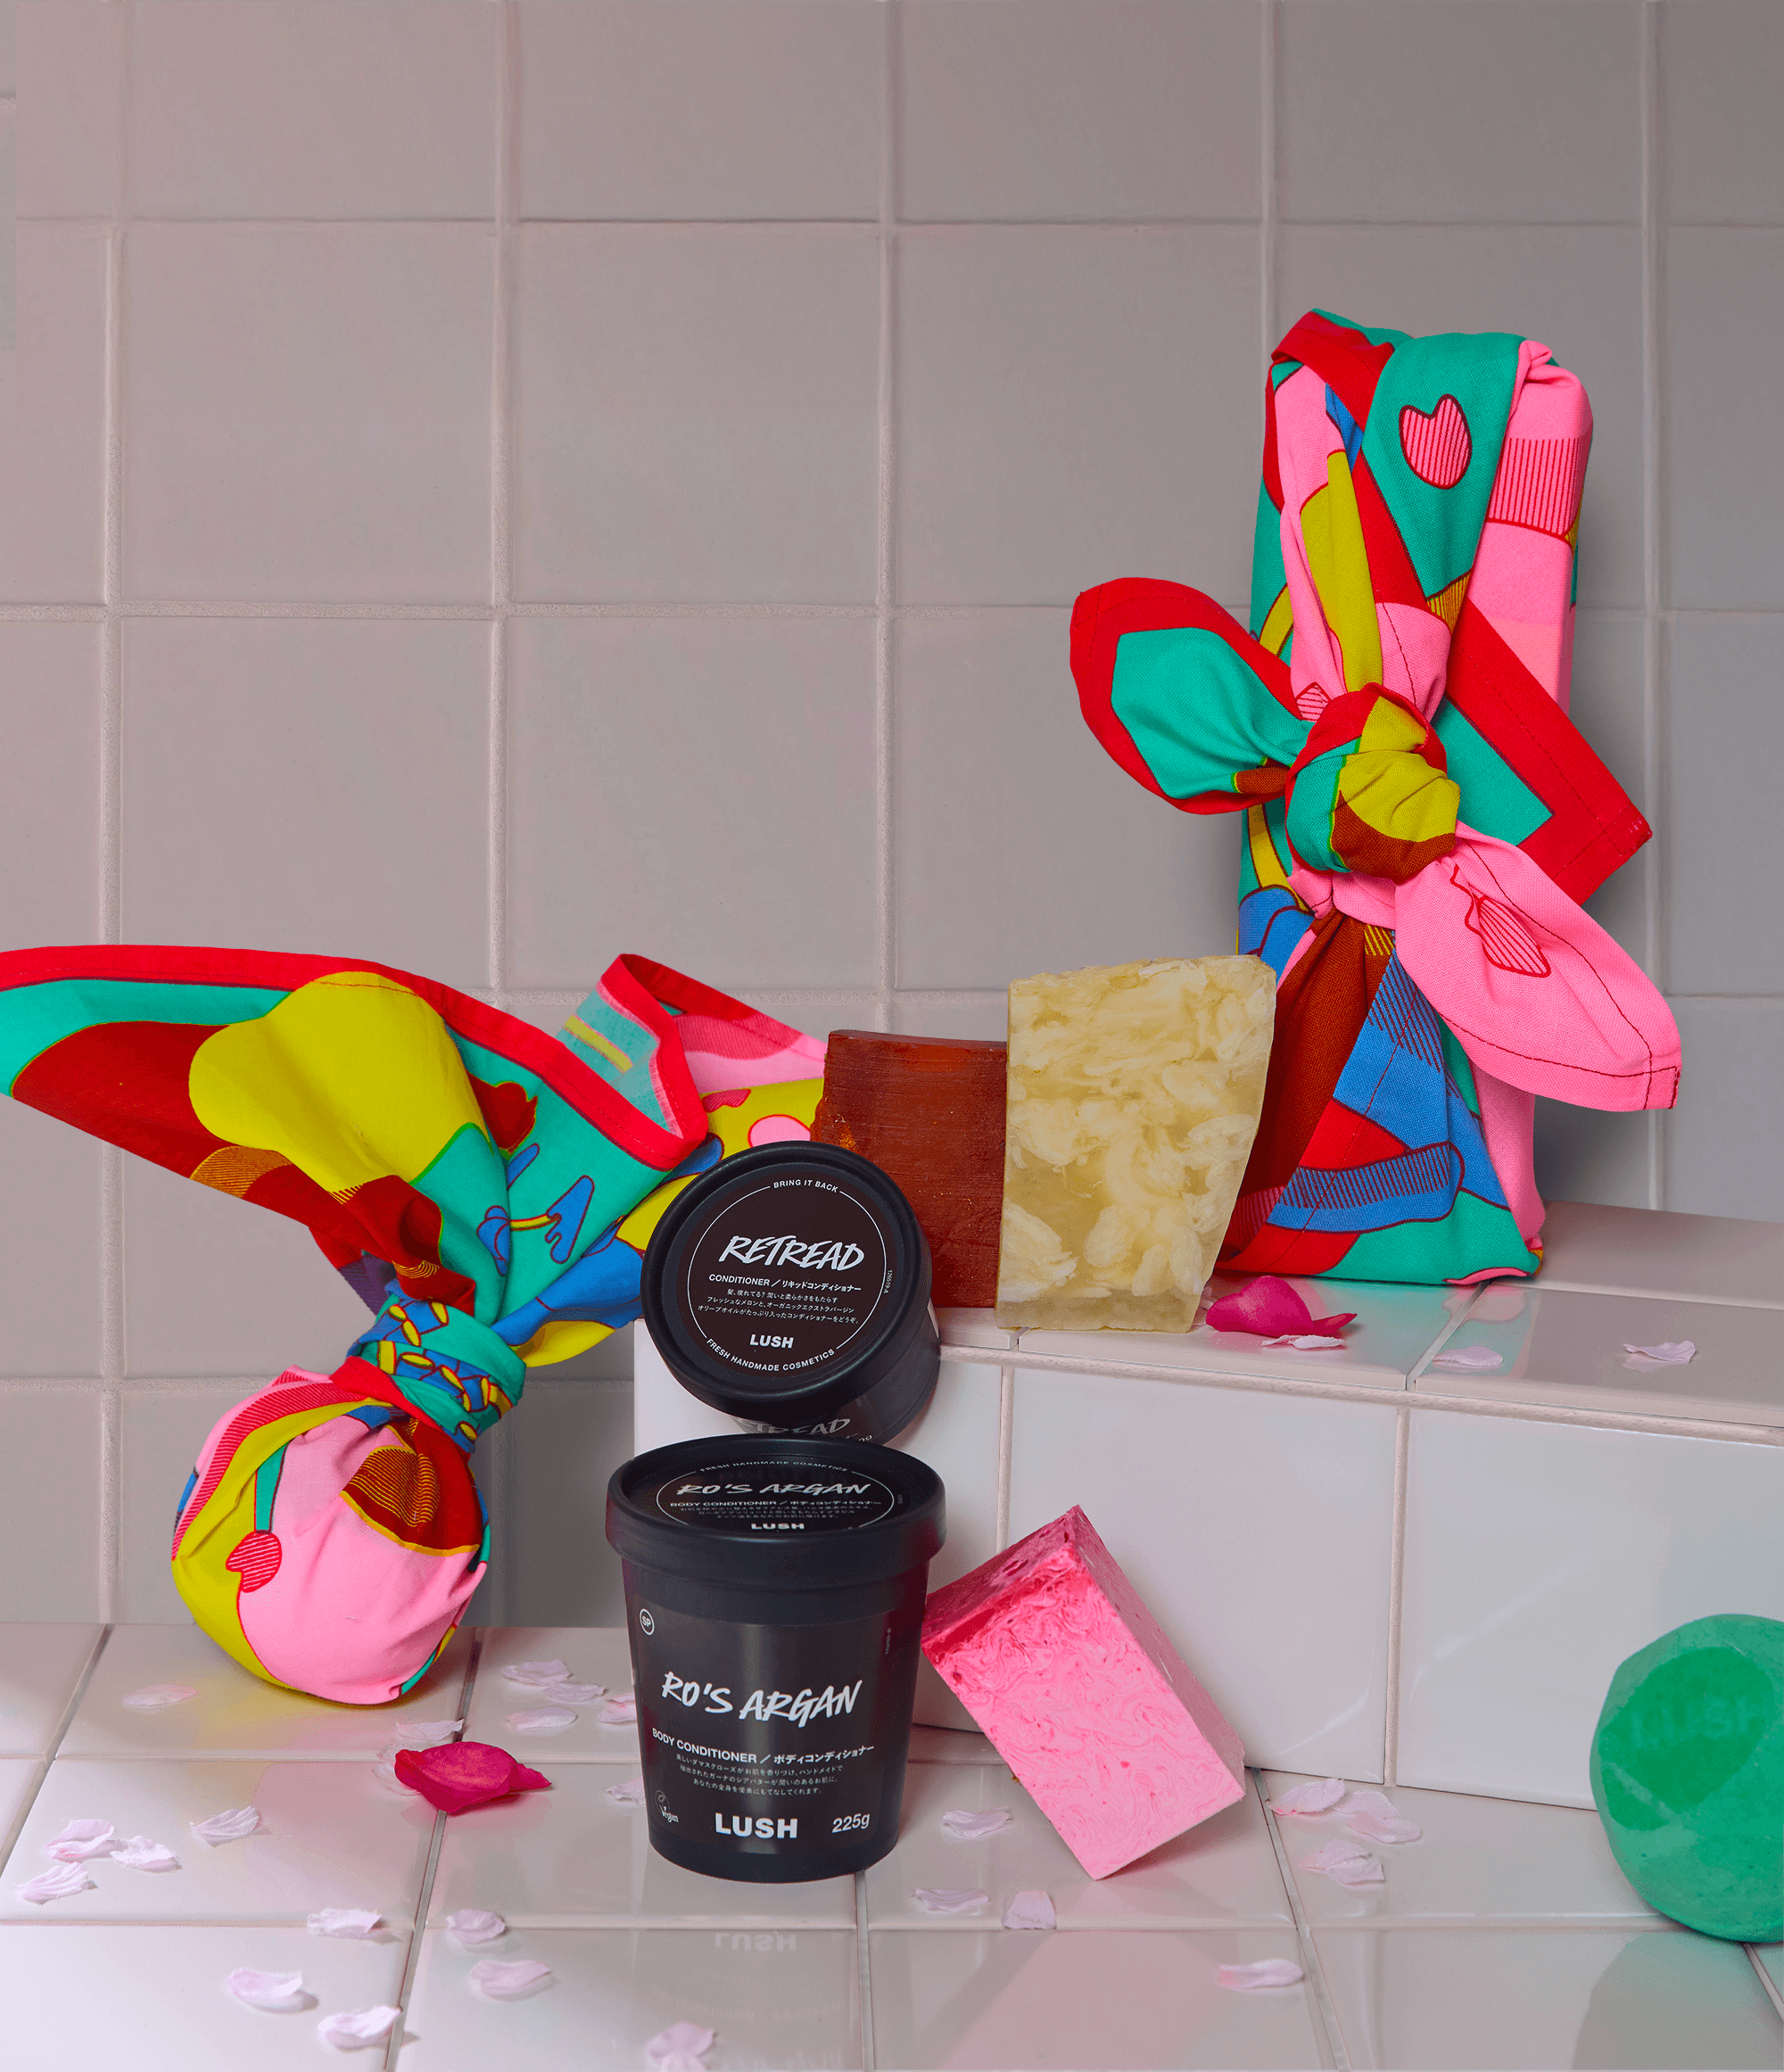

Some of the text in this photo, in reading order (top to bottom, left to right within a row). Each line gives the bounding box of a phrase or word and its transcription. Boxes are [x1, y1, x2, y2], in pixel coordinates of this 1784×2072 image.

[773, 1178, 839, 1193] BRING IT BACK
[719, 1234, 865, 1271] RETREAD
[708, 1274, 771, 1287] CONDITIONER
[781, 1280, 862, 1292] リキッドコンディショナー
[749, 1333, 794, 1349] LUSH
[706, 1338, 835, 1372] FRESH HANDMADE COSMETICS
[676, 1483, 871, 1497] RO'S ARGAN
[751, 1522, 805, 1531] LUSH
[661, 1671, 863, 1729] RO'S ARGAN
[652, 1727, 675, 1747] BODY
[676, 1739, 757, 1764] CONDITIONER
[772, 1745, 875, 1765] ボディコンディショナー
[714, 1812, 871, 1839] LUSH 225g
